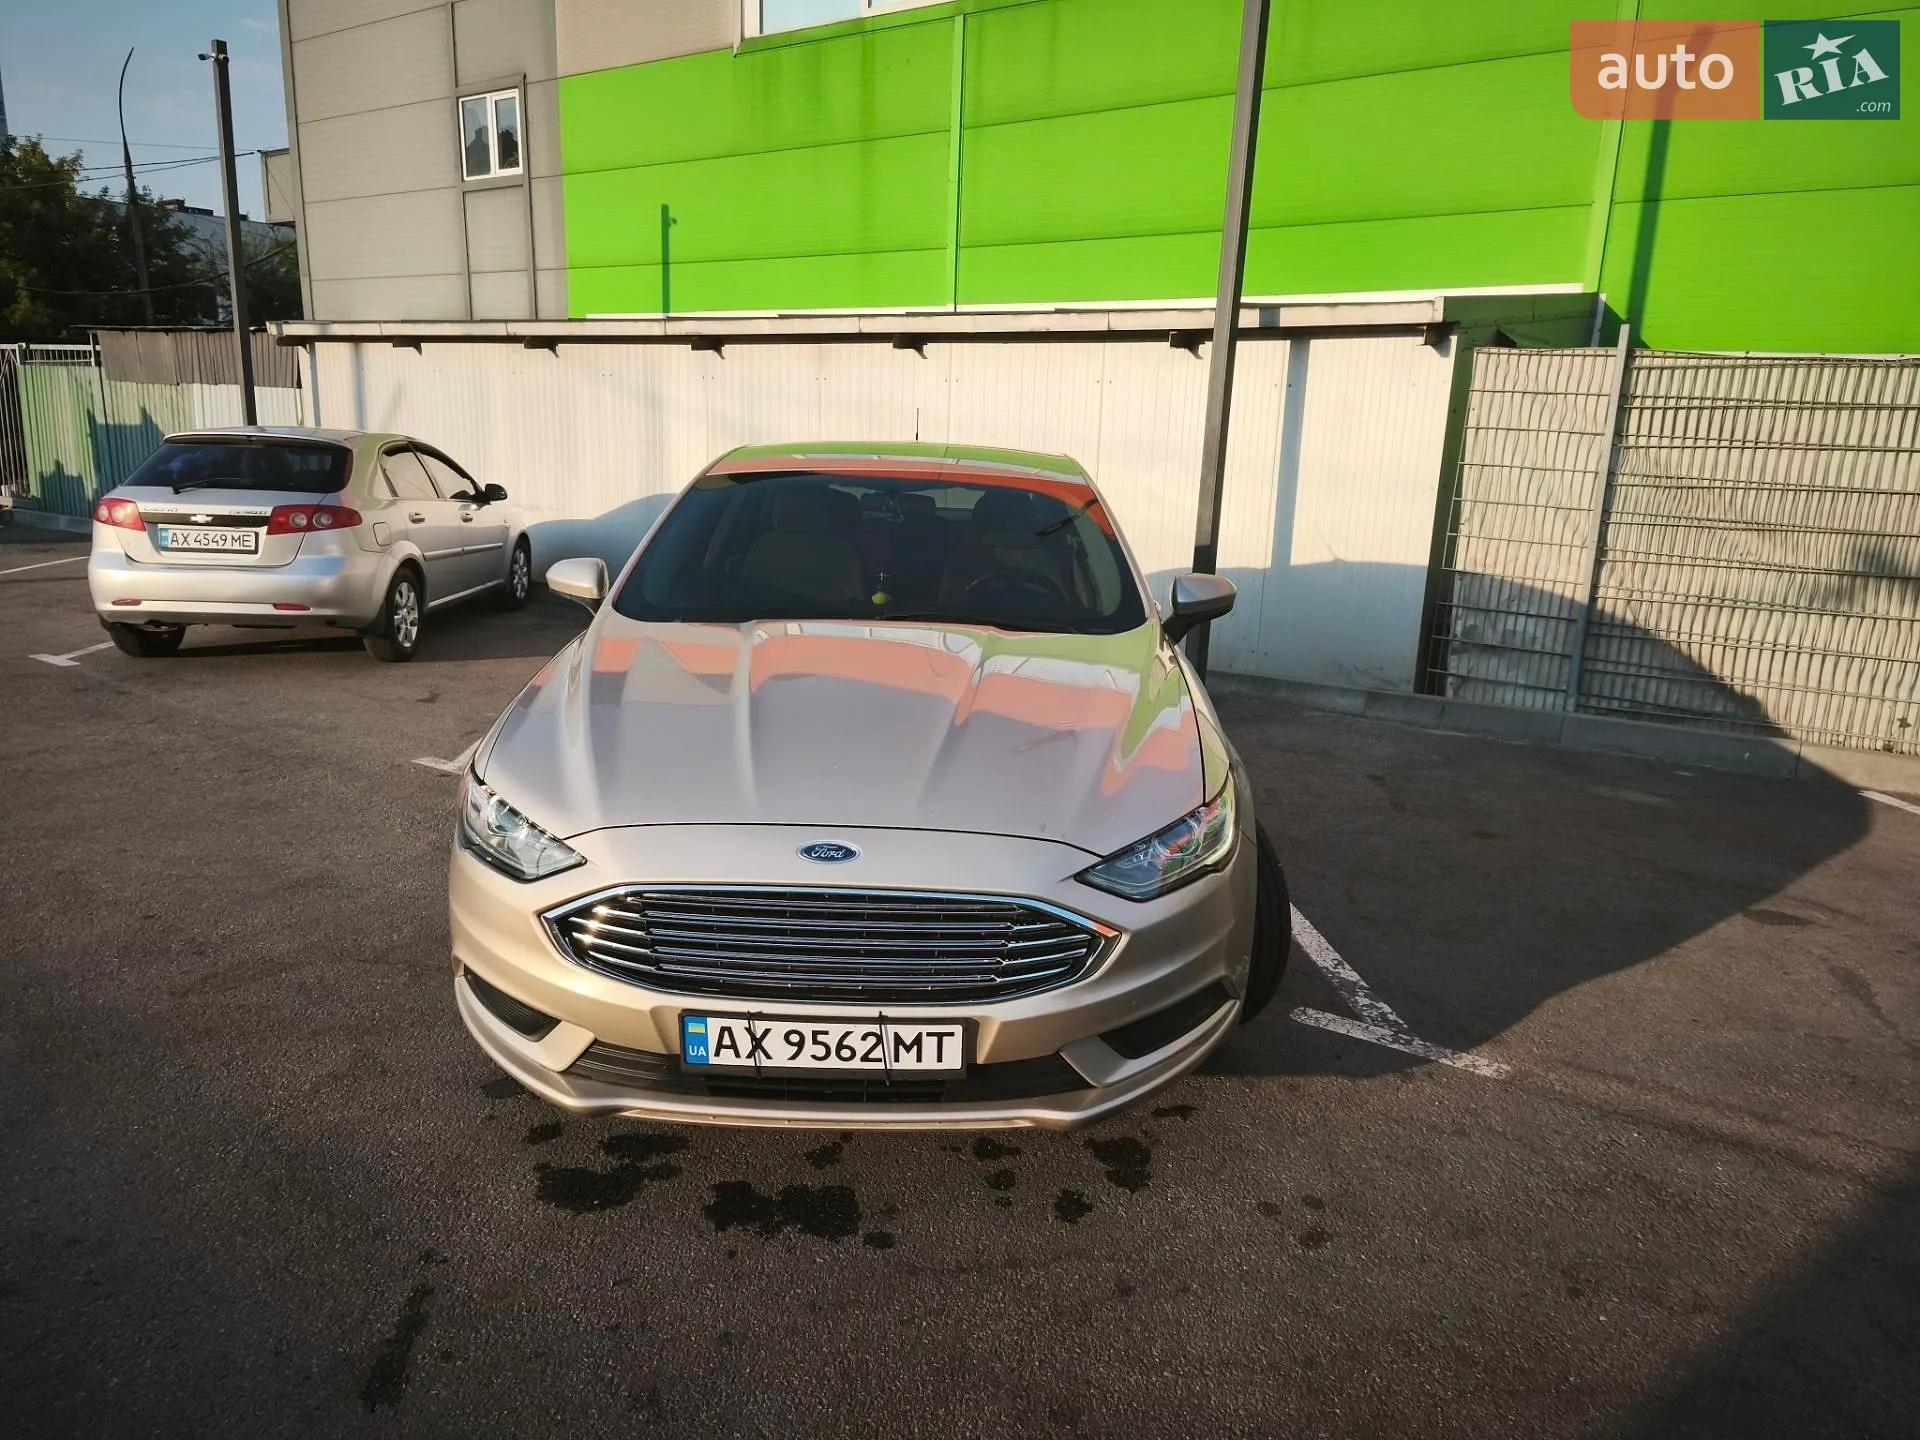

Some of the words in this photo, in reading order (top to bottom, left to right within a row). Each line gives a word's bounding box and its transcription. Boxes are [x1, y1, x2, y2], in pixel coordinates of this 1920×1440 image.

[170, 532, 190, 547] AX
[194, 532, 228, 548] 4549
[231, 533, 252, 549] ME
[811, 845, 847, 858] Ford
[689, 1045, 707, 1058] UA
[713, 1025, 773, 1061] AX
[783, 1028, 882, 1063] 9562
[893, 1031, 955, 1064] MT
